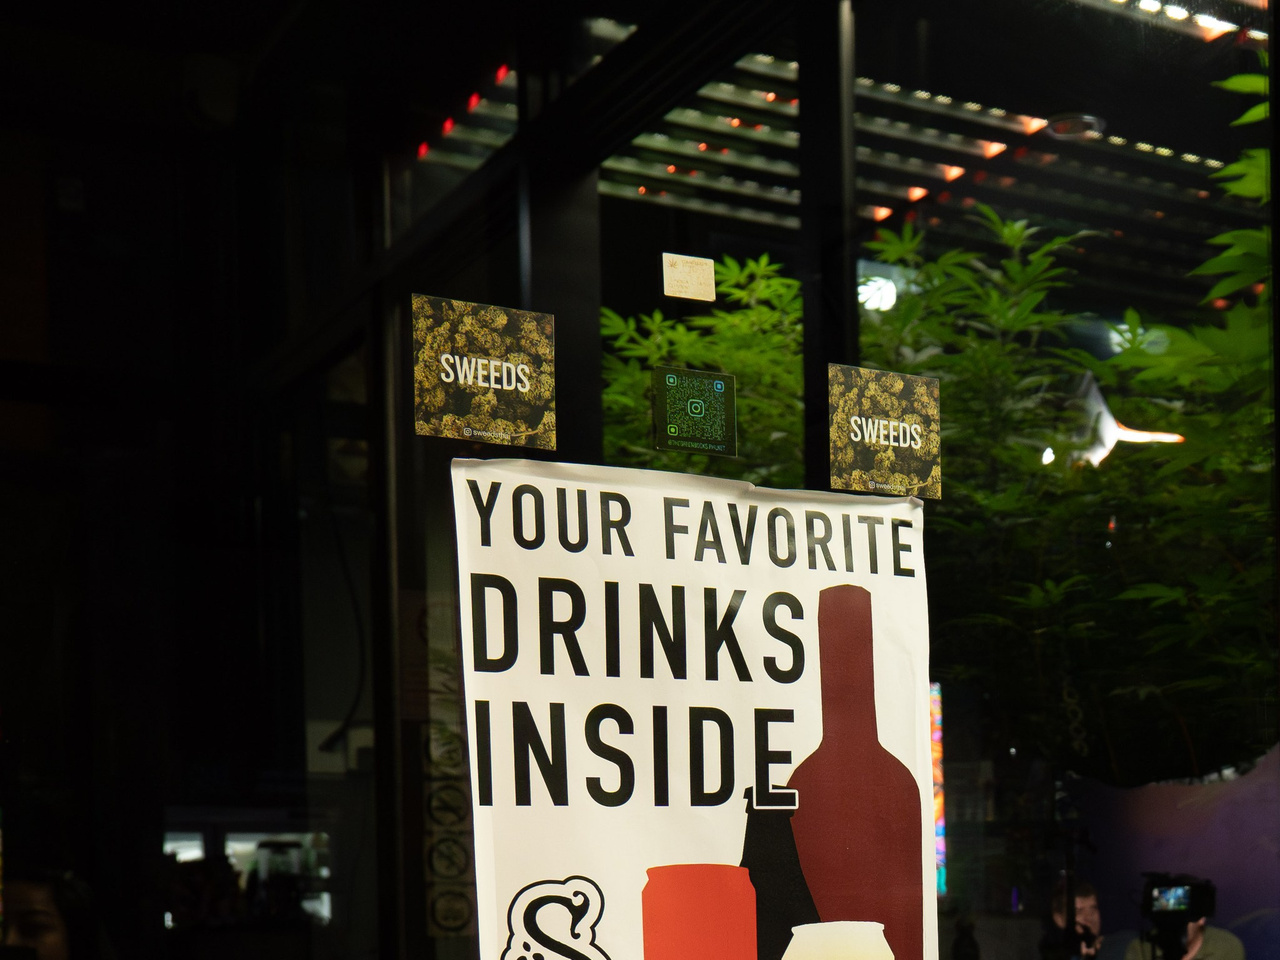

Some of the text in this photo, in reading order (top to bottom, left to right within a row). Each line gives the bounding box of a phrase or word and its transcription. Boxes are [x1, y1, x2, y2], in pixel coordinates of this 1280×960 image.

[440, 353, 531, 393] SWEEDS
[850, 415, 922, 450] SWEEDS
[467, 480, 915, 578] YOUR FAVORITE
[471, 573, 805, 684] DRINKS
[474, 700, 798, 808] INSIDE
